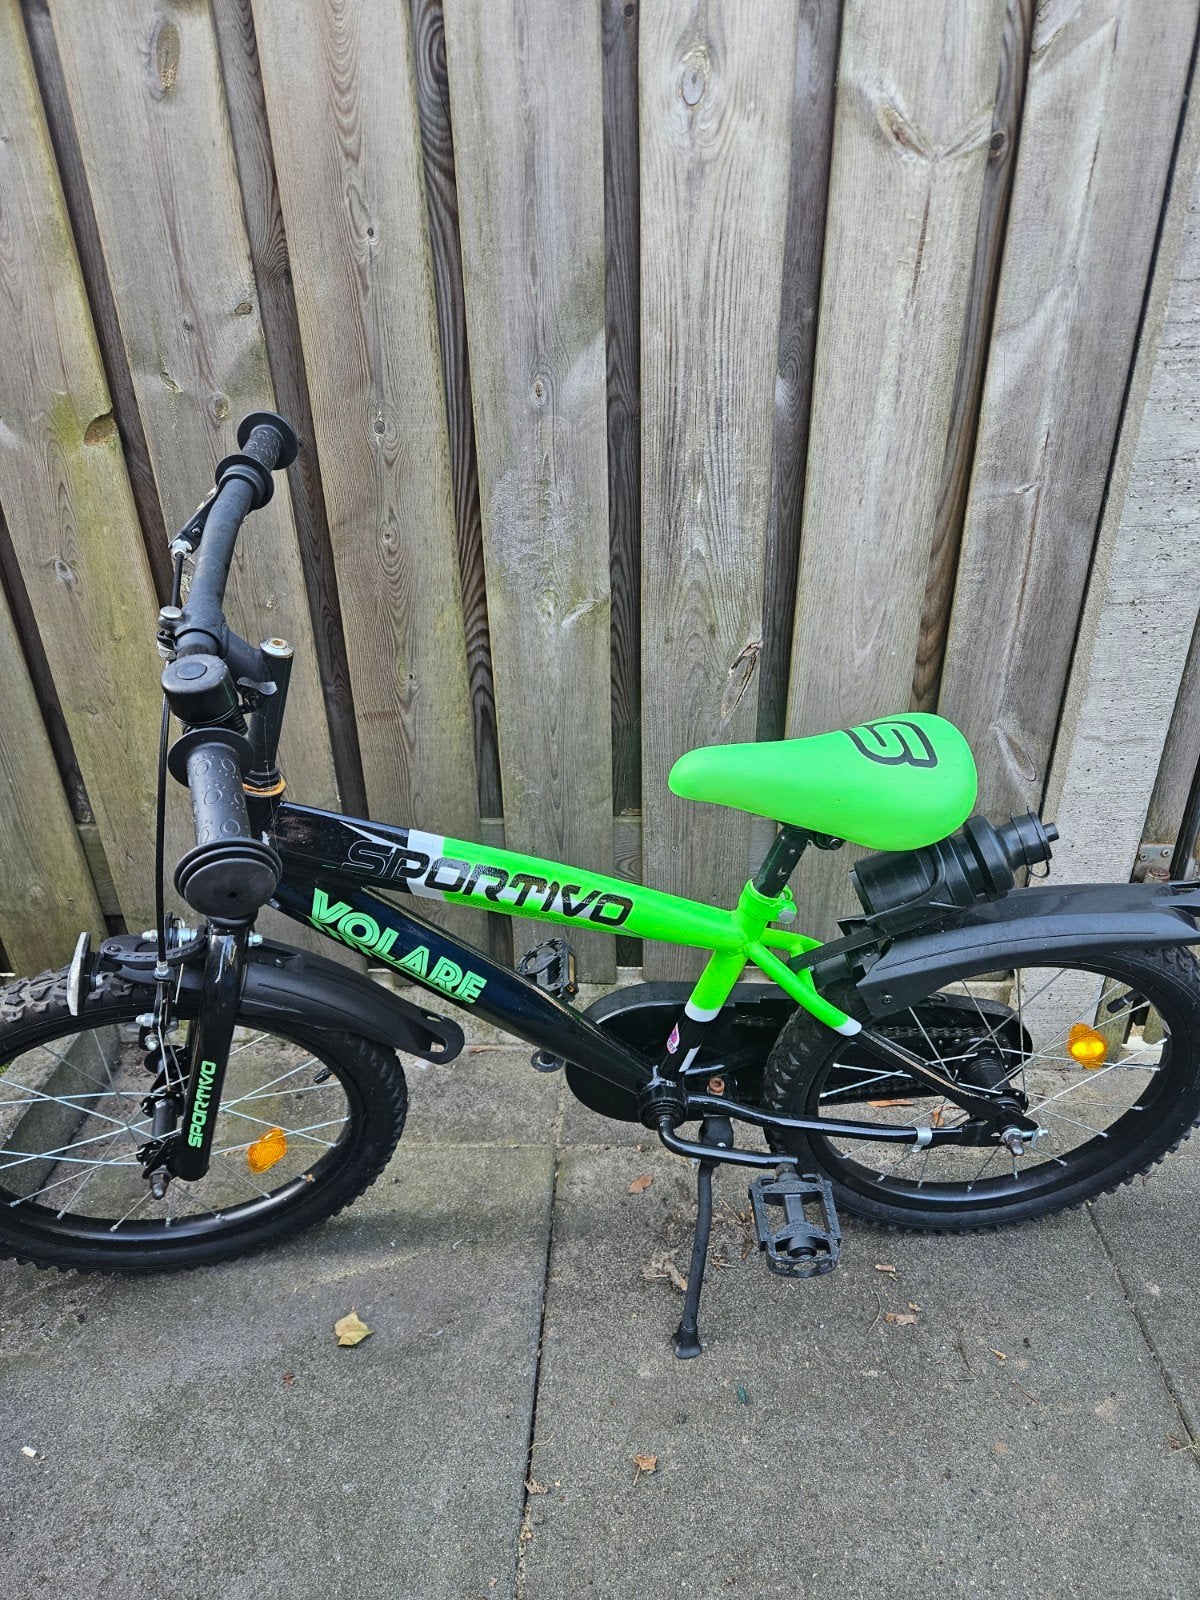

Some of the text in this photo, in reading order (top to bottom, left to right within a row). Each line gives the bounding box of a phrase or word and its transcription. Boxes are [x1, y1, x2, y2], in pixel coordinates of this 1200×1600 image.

[341, 839, 634, 927] SPORTIVO
[310, 887, 488, 1004] VOLARE
[187, 1060, 217, 1149] SPORTIVO
